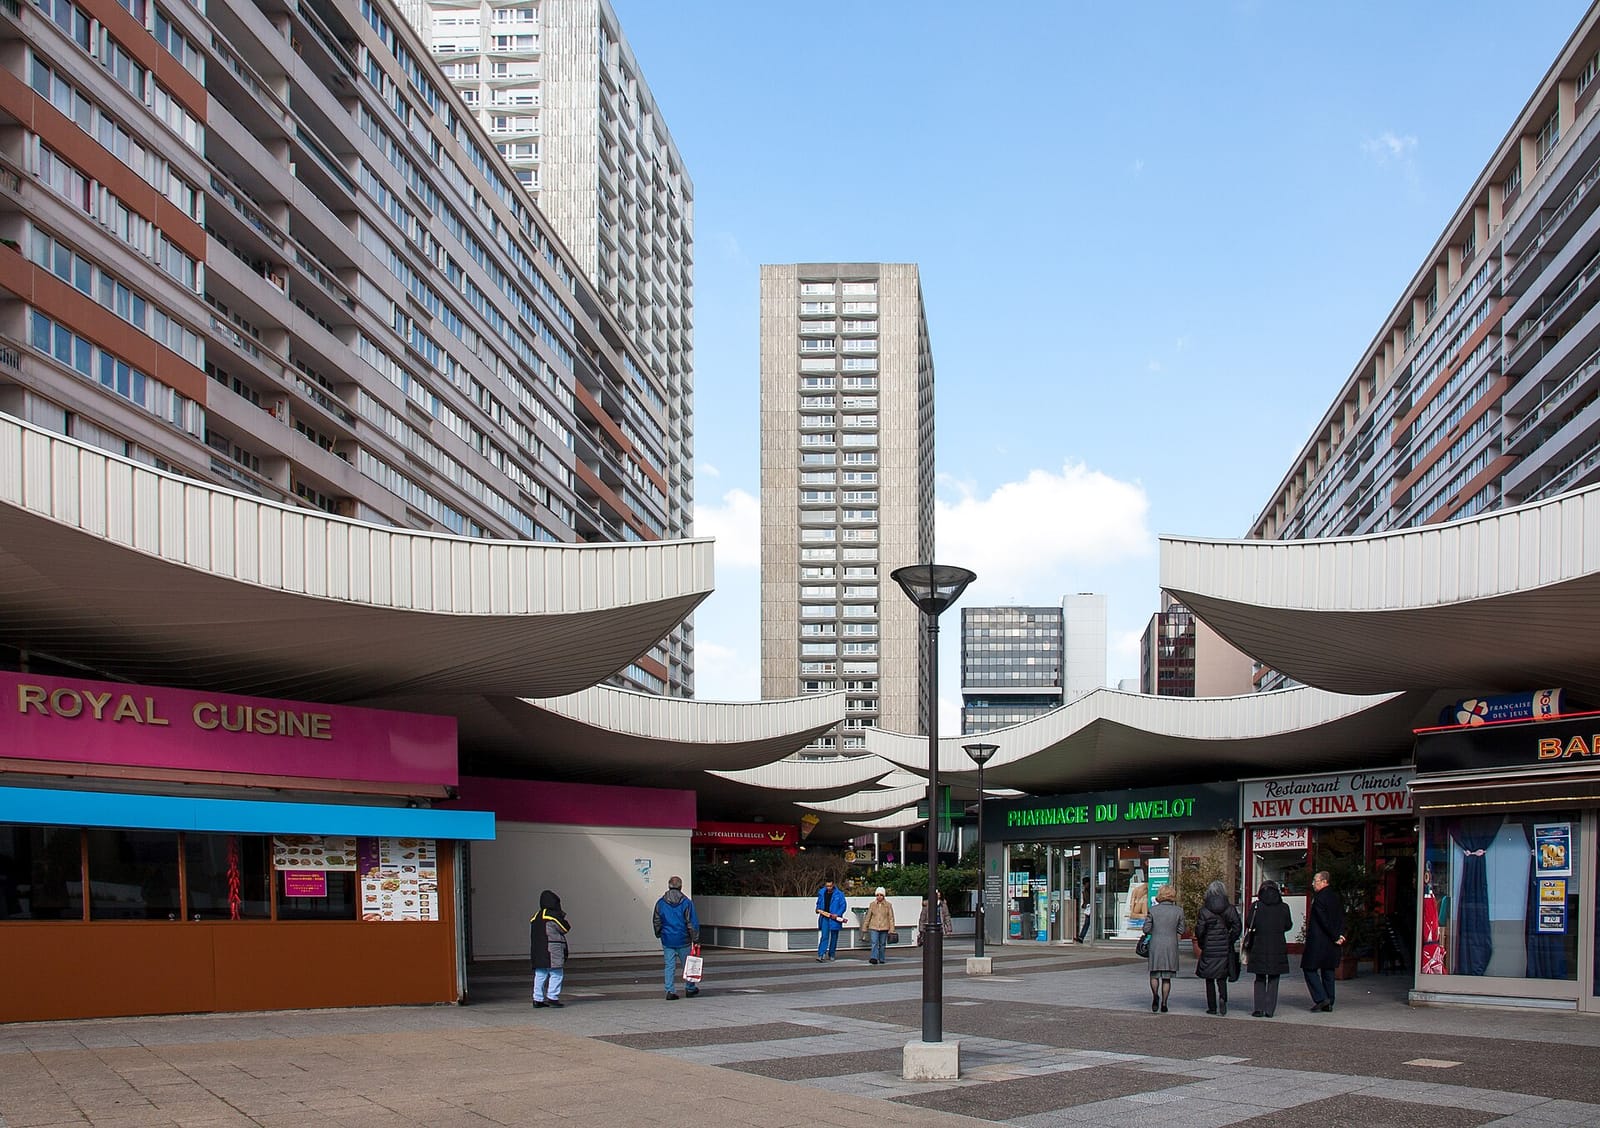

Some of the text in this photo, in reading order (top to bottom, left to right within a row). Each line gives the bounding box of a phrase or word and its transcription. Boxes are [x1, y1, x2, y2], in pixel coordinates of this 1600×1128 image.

[17, 684, 333, 740] ROYAL CUISINE
[1489, 701, 1531, 711] FRANÇAISE
[1510, 710, 1529, 718] JEUX
[1264, 773, 1402, 798] Restaurant Chinois
[1008, 798, 1196, 827] PHARMACIE DU JAVELOT
[1252, 799, 1294, 818] NEW
[1299, 794, 1358, 815] CHINA
[1275, 840, 1305, 848] EMPORTER
